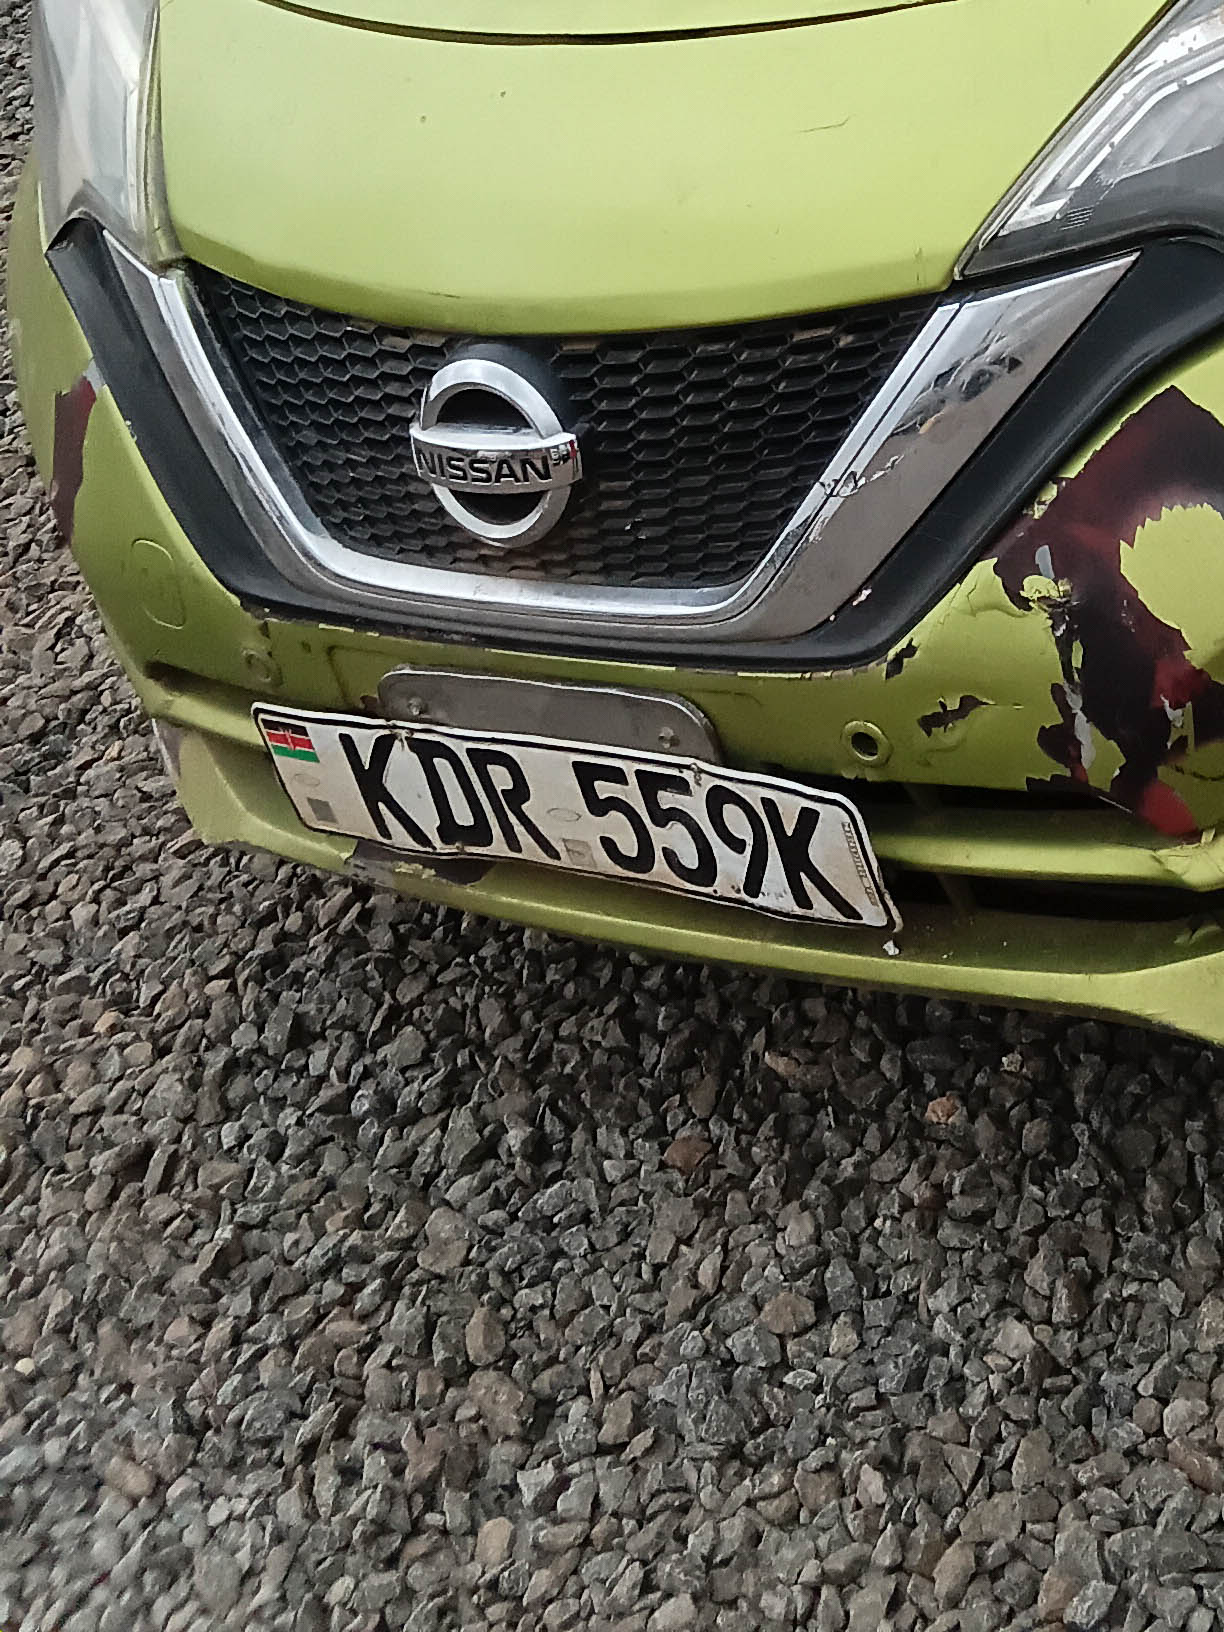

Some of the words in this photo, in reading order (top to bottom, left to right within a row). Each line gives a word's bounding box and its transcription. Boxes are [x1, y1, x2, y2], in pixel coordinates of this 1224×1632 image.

[417, 451, 553, 486] NISSAN
[338, 733, 561, 861] KDR
[573, 760, 863, 920] 559K
